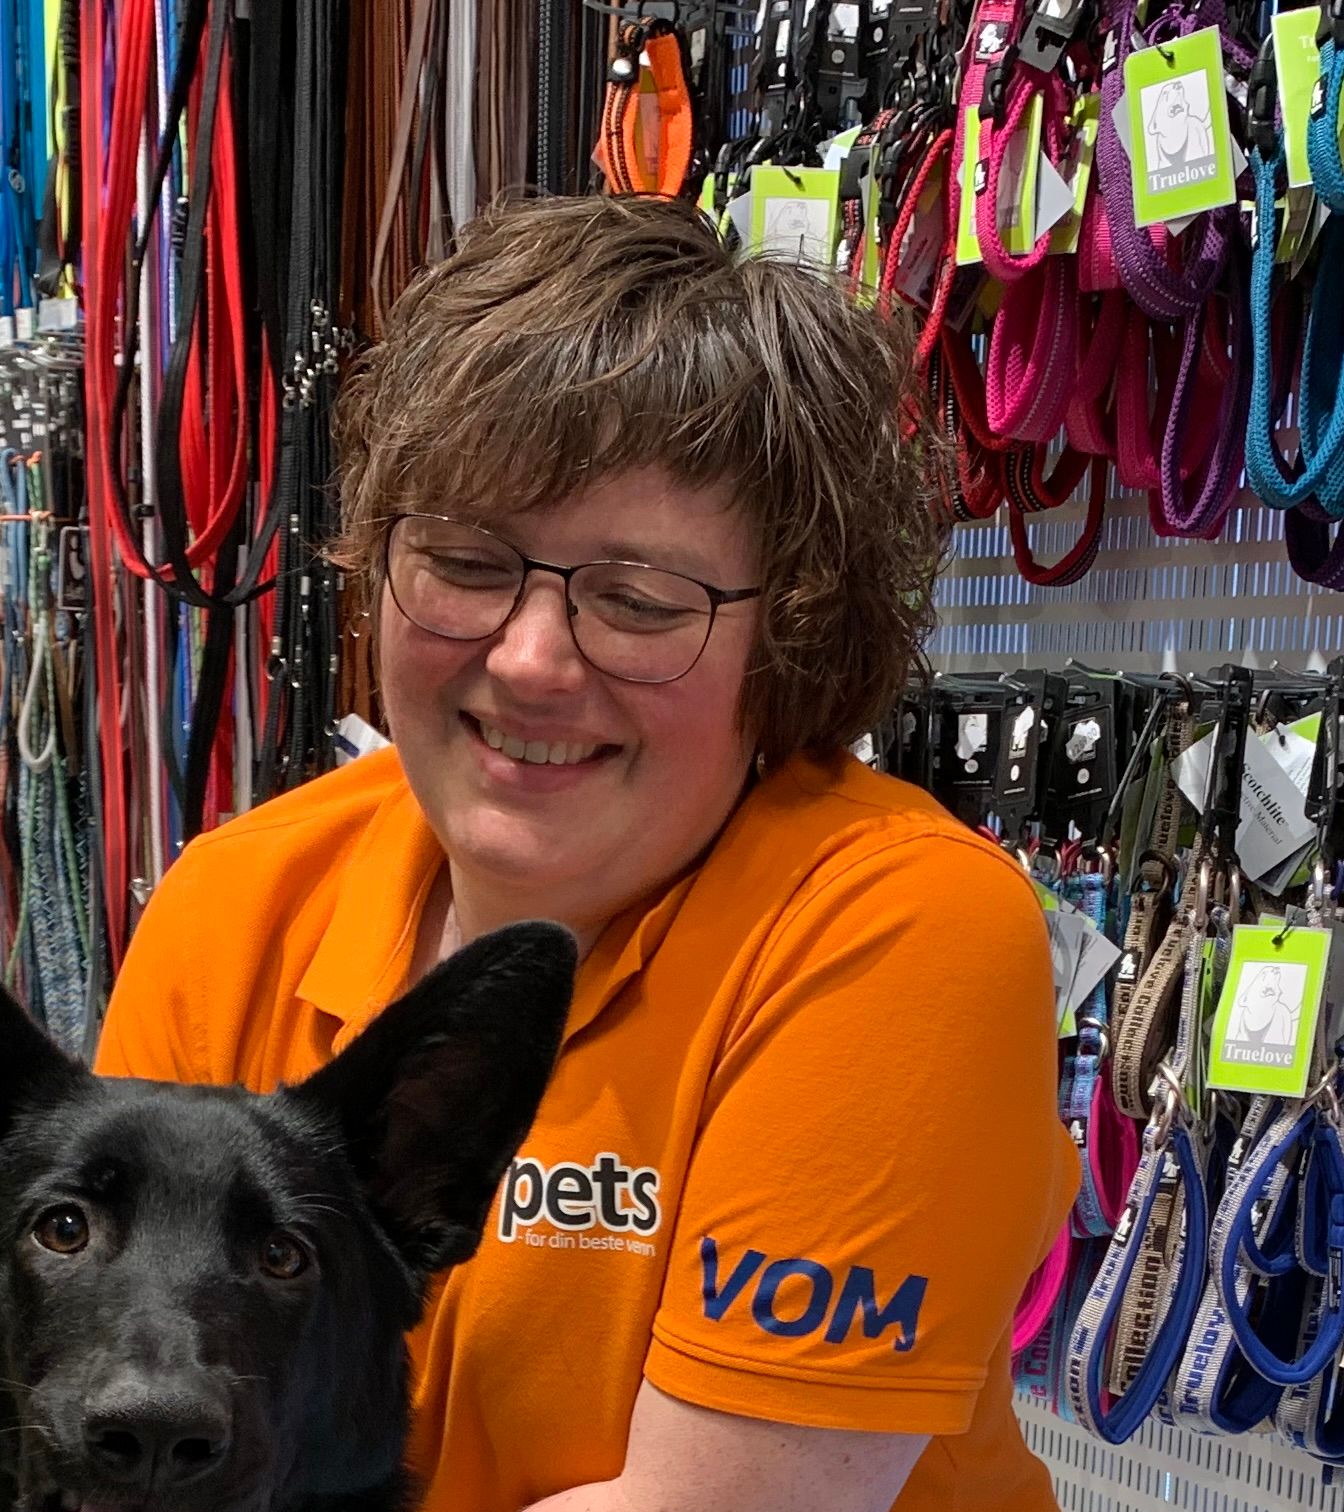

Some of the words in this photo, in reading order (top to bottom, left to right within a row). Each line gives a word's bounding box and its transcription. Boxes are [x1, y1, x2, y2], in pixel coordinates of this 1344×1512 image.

[1148, 161, 1216, 193] Truelove
[1224, 1043, 1294, 1066] Truelove
[500, 1154, 659, 1240] pets
[525, 1228, 546, 1247] for
[548, 1230, 576, 1249] din
[578, 1232, 625, 1251] beste
[626, 1238, 657, 1257] venn
[700, 1236, 929, 1353] VOM
[1179, 1309, 1227, 1415] Truelov
